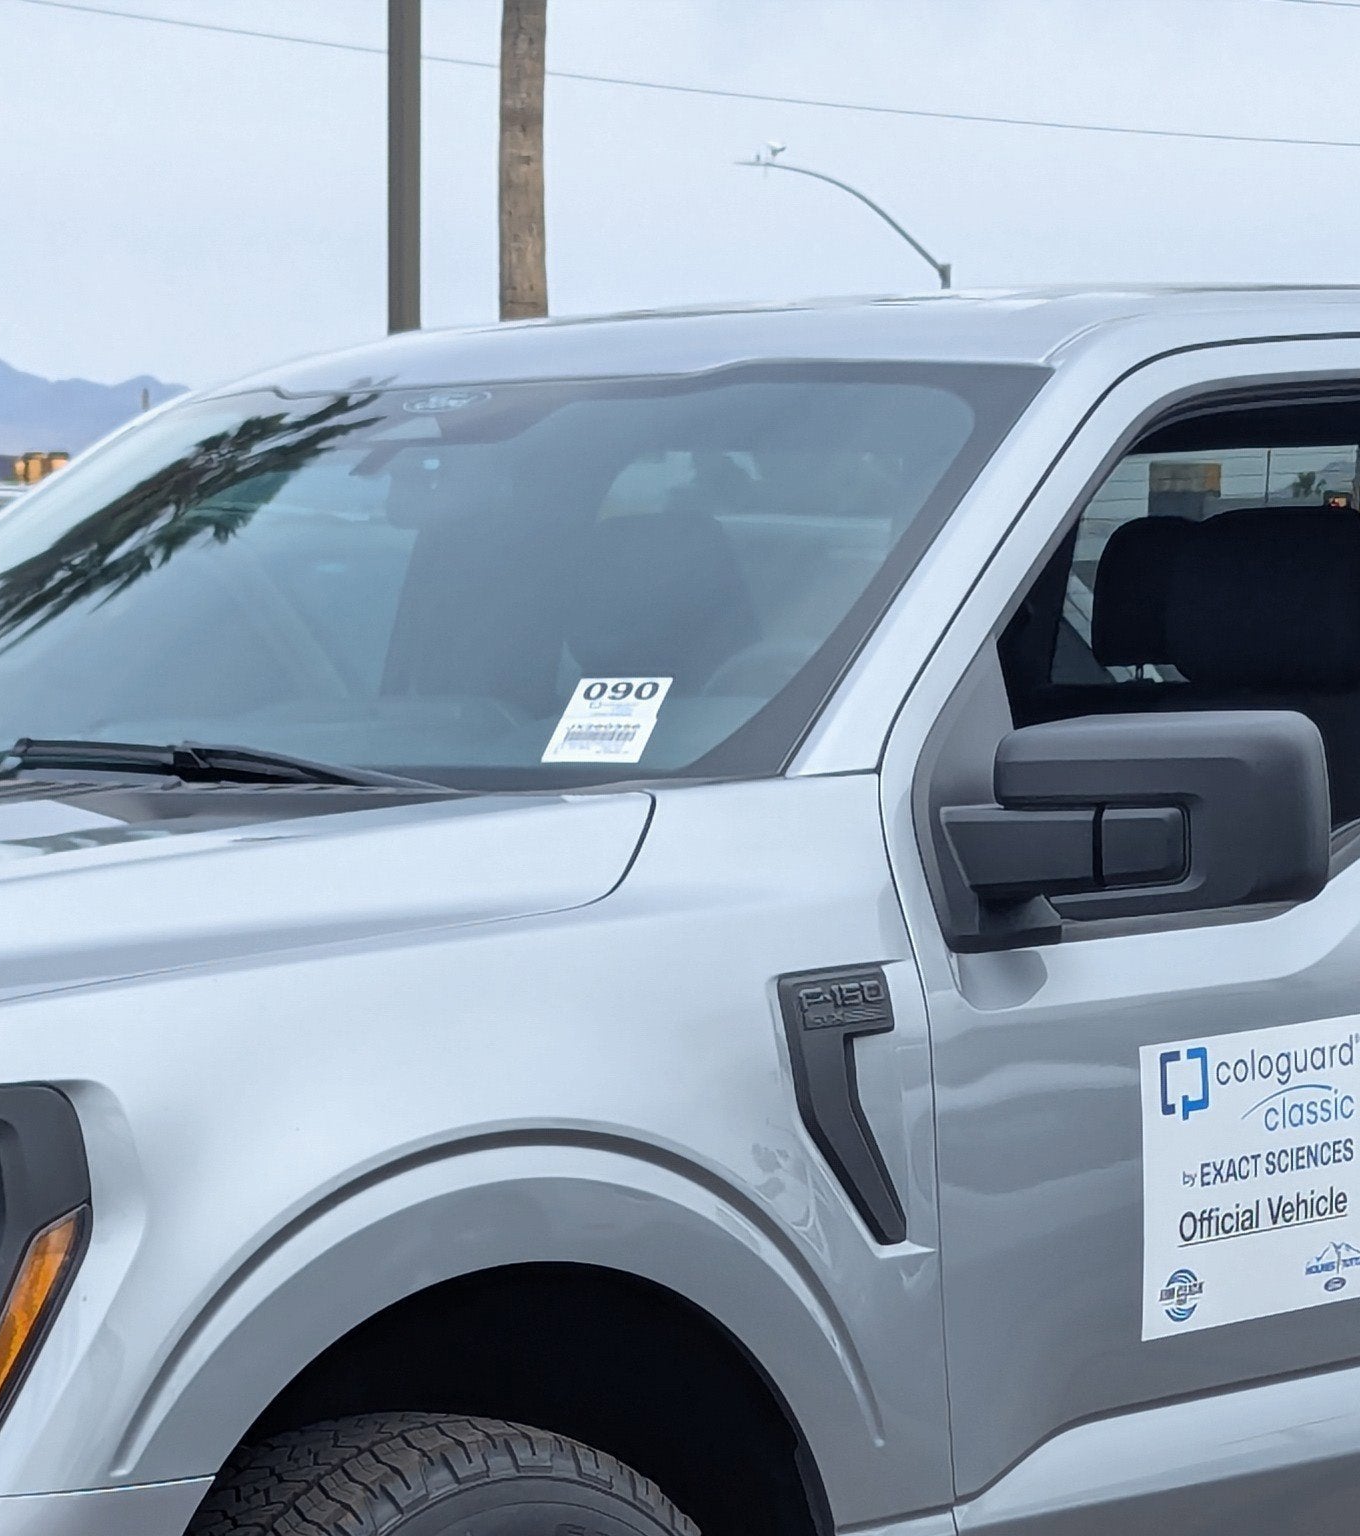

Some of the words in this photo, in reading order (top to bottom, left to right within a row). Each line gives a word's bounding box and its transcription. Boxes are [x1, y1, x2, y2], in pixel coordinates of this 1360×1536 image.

[583, 681, 659, 701] 090
[1264, 1088, 1355, 1132] classic
[1182, 1170, 1197, 1187] by
[1200, 1154, 1261, 1187] EXACT
[1265, 1138, 1354, 1176] SCIENCES
[1179, 1199, 1260, 1242] Official
[1267, 1186, 1348, 1228] Vehicle
